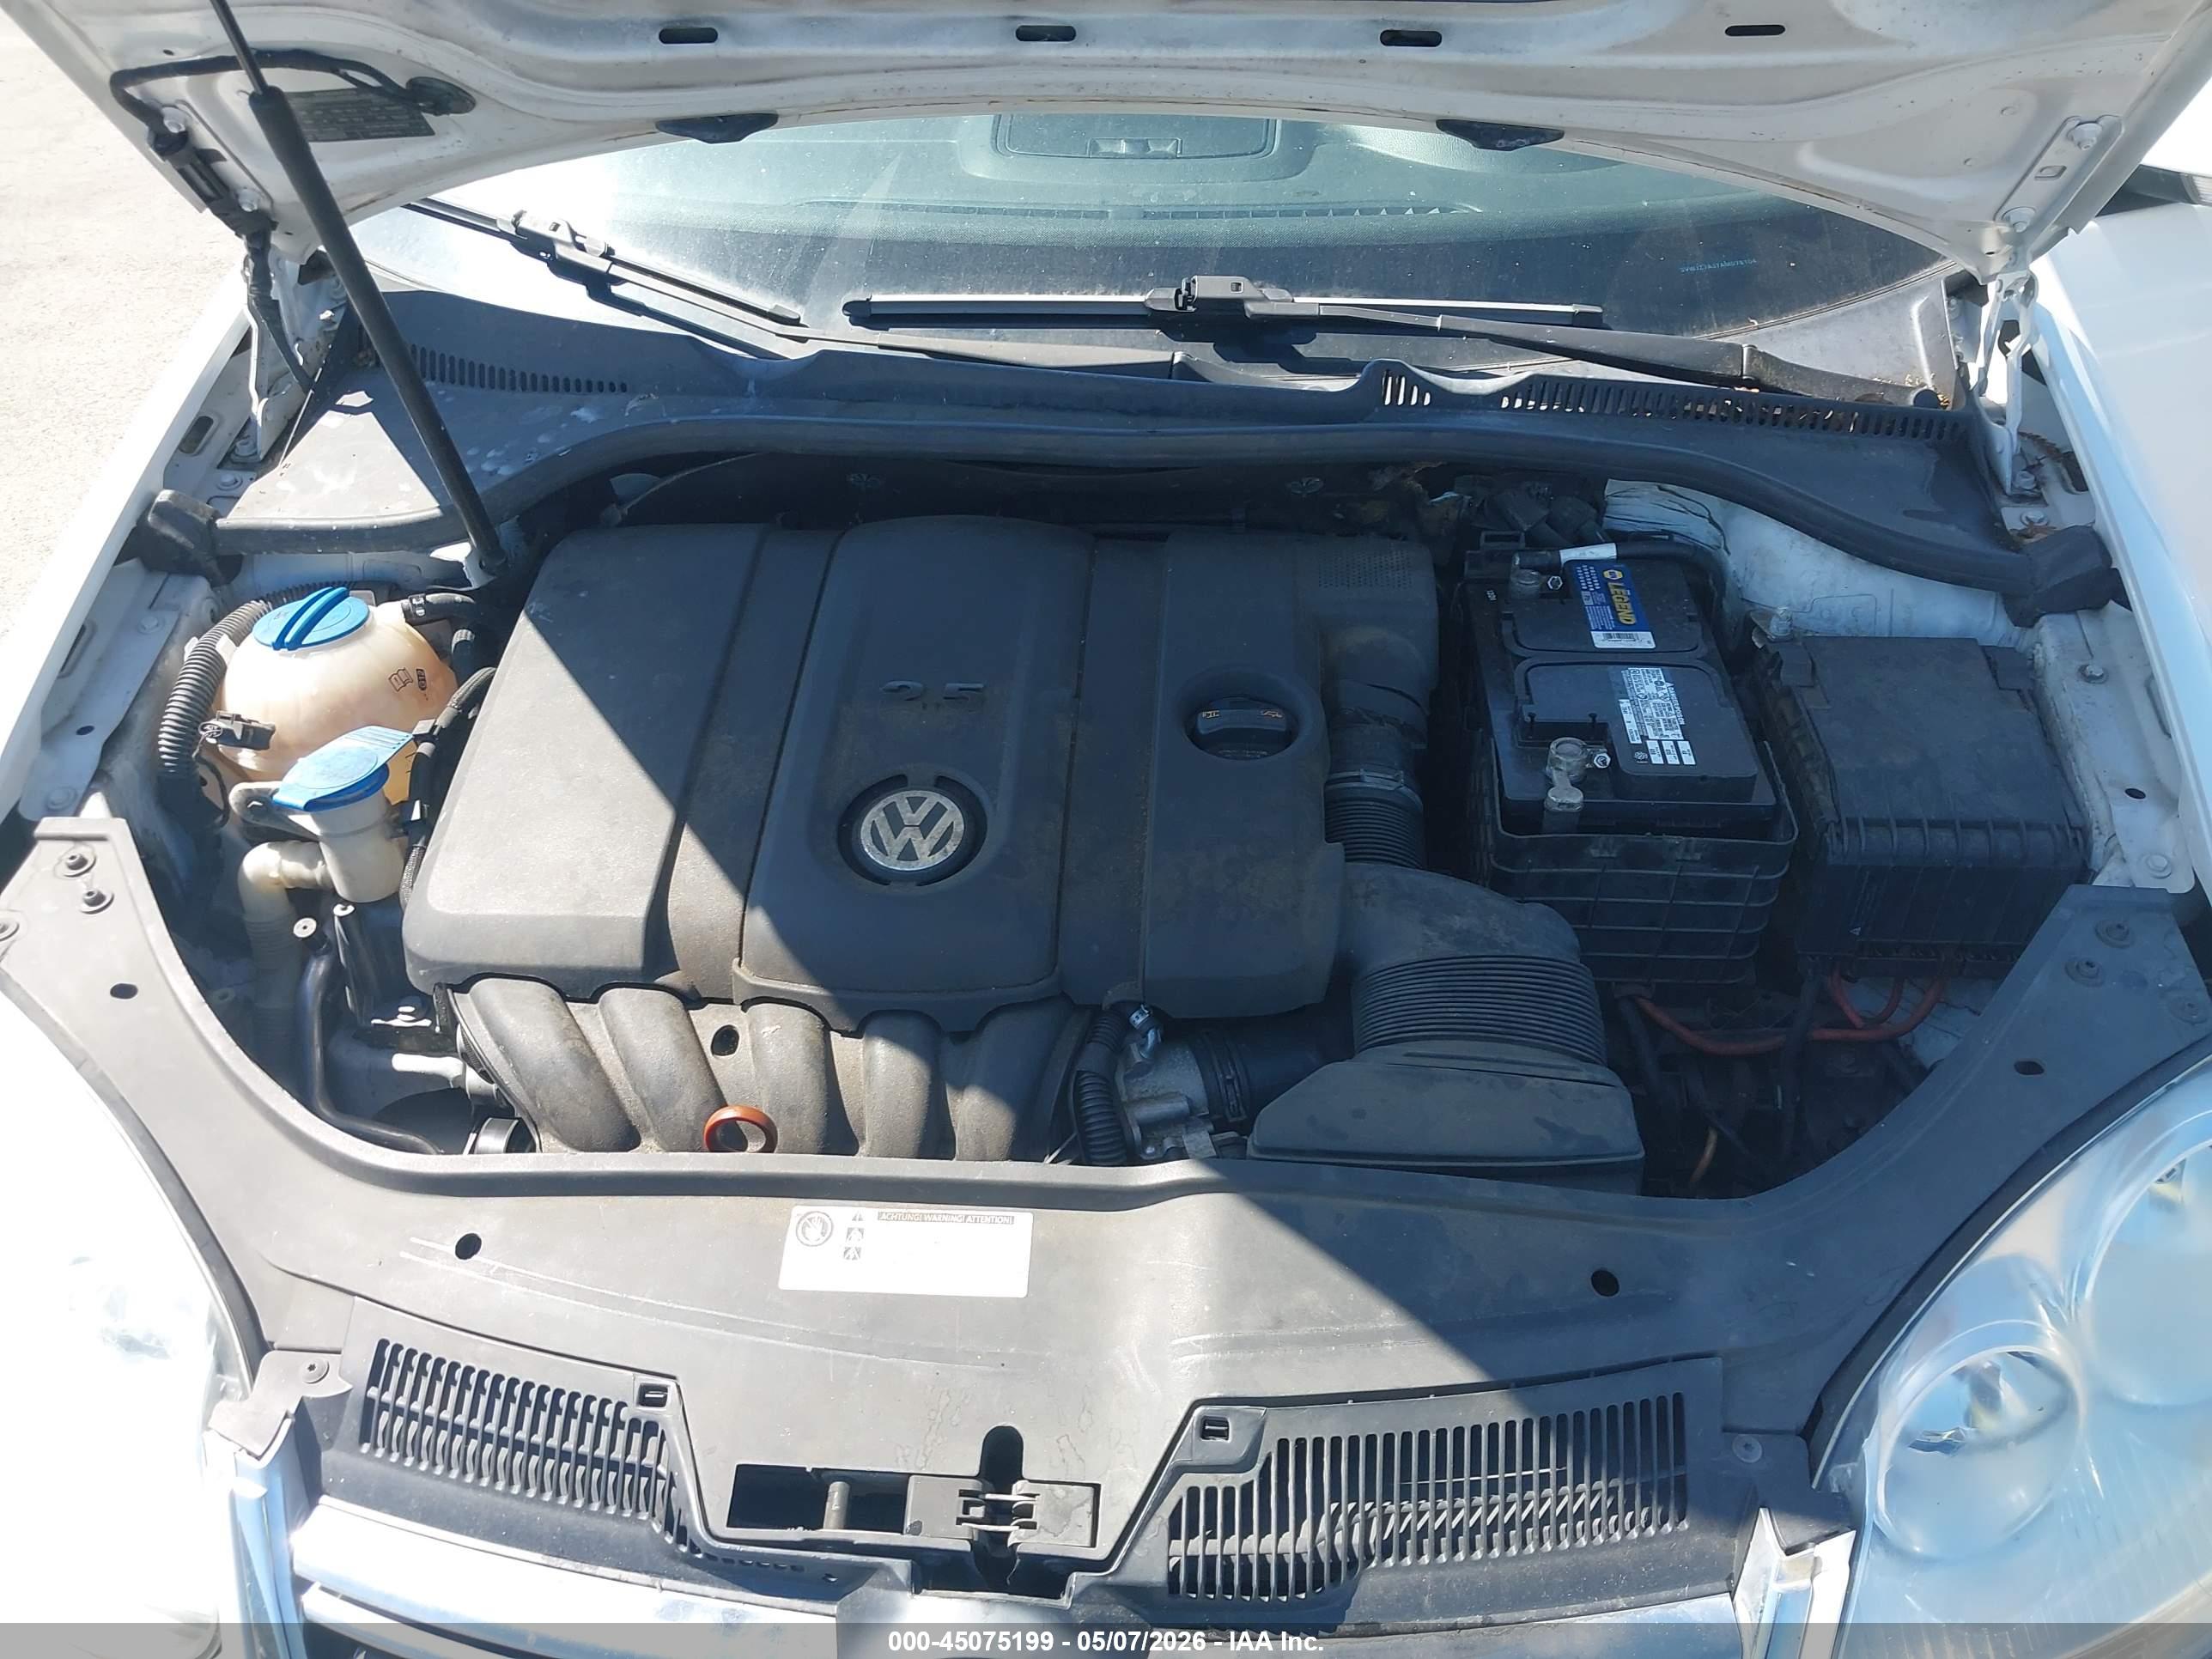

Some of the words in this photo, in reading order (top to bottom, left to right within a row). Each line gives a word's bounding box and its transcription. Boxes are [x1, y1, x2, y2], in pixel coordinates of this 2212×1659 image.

[1607, 582, 1637, 625] LEGEND
[860, 790, 964, 871] VW
[880, 1212, 921, 1222] ACHTUNG!
[924, 1213, 965, 1223] WARNING!
[967, 1214, 1012, 1224] ATTENTION!
